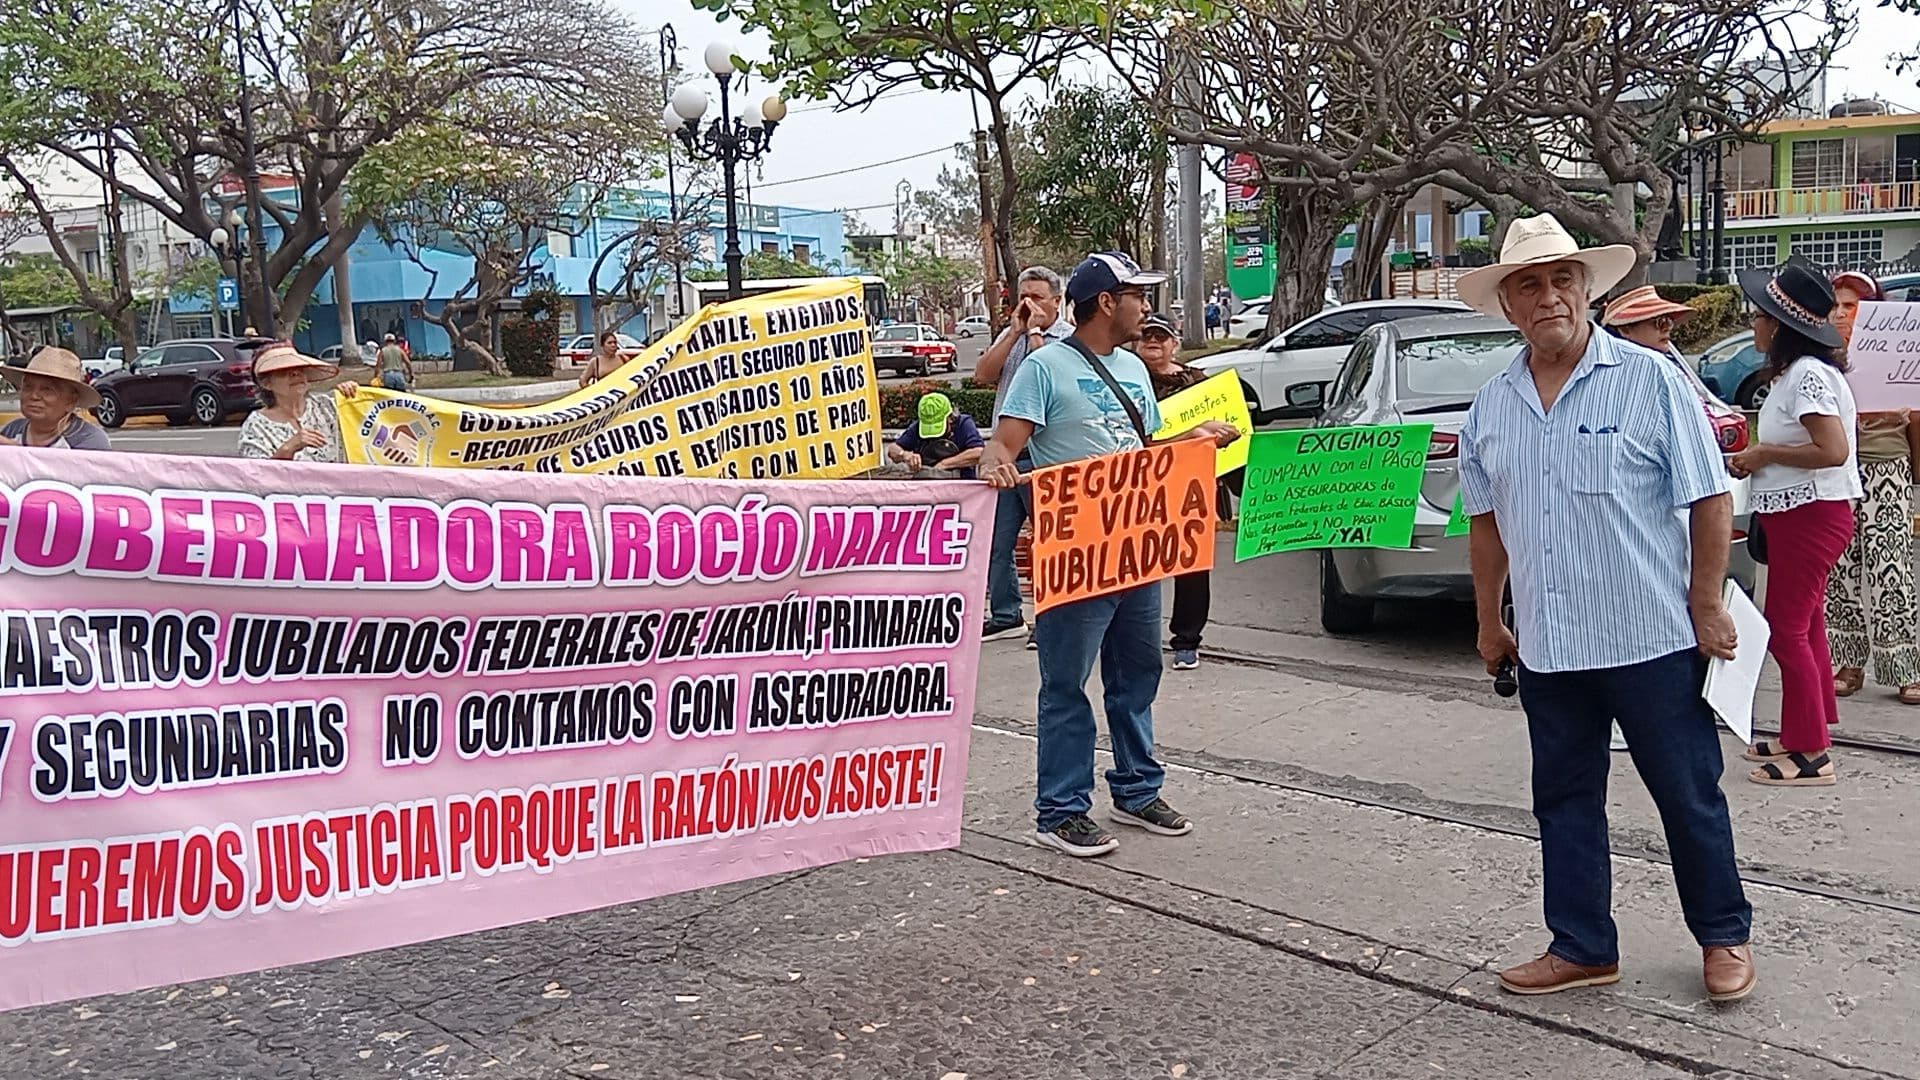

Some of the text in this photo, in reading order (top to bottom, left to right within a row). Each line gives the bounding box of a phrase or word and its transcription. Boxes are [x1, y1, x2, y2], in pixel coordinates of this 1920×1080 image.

[223, 288, 232, 301] P
[767, 296, 863, 336] EXIGIMOS:
[743, 341, 804, 376] SEGURO
[809, 336, 830, 363] DE
[830, 329, 864, 356] VIDA
[1857, 338, 1888, 352] una
[1887, 360, 1920, 381] JU
[361, 399, 427, 437] CONJUPEVER
[571, 416, 668, 467] SEGUROS
[677, 383, 779, 435] ATRSADOS
[790, 376, 811, 402] 10
[821, 365, 865, 396] AÑOS
[1180, 394, 1228, 423] maestros
[655, 450, 684, 477] DE
[796, 410, 820, 436] DE
[828, 399, 871, 430] PAGO.
[752, 450, 798, 479] CON
[810, 443, 836, 469] LA
[846, 431, 874, 460] SEV
[1296, 431, 1403, 454] EXIGIMOS
[1037, 446, 1174, 505] SEGURO
[1247, 461, 1321, 490] CUMPLAN
[1360, 452, 1373, 470] el
[1382, 449, 1424, 468] PAGO
[1283, 482, 1376, 501] ASEGURADORAS
[1381, 477, 1395, 490] de
[1039, 479, 1208, 544] DE VIDA A
[1323, 516, 1343, 529] NO
[1353, 514, 1387, 526] PAGAN
[1337, 499, 1348, 510] de
[1379, 495, 1415, 508] BÁSICA
[0, 488, 969, 584] OBERNADORA ROCÍO NAHLE:
[1328, 526, 1372, 544] ¡YA!
[1036, 520, 1206, 603] JUBILADOS
[0, 614, 216, 690] AESTROS
[223, 616, 465, 679] JUBILADOS
[467, 612, 662, 673] FEDERALES
[660, 611, 705, 657] DE
[35, 703, 346, 796] SECUNDARIAS
[386, 696, 440, 760] NO
[459, 682, 654, 754] CONTAMOS
[669, 677, 737, 735] CON
[748, 666, 952, 729] ASEGURADORA.
[0, 830, 243, 939] UEREMOS
[255, 804, 441, 907] JUSTICIA
[450, 785, 597, 874] PORQUE
[604, 781, 643, 849] LA
[652, 759, 761, 842] RAZÓN
[763, 761, 828, 825] NOS
